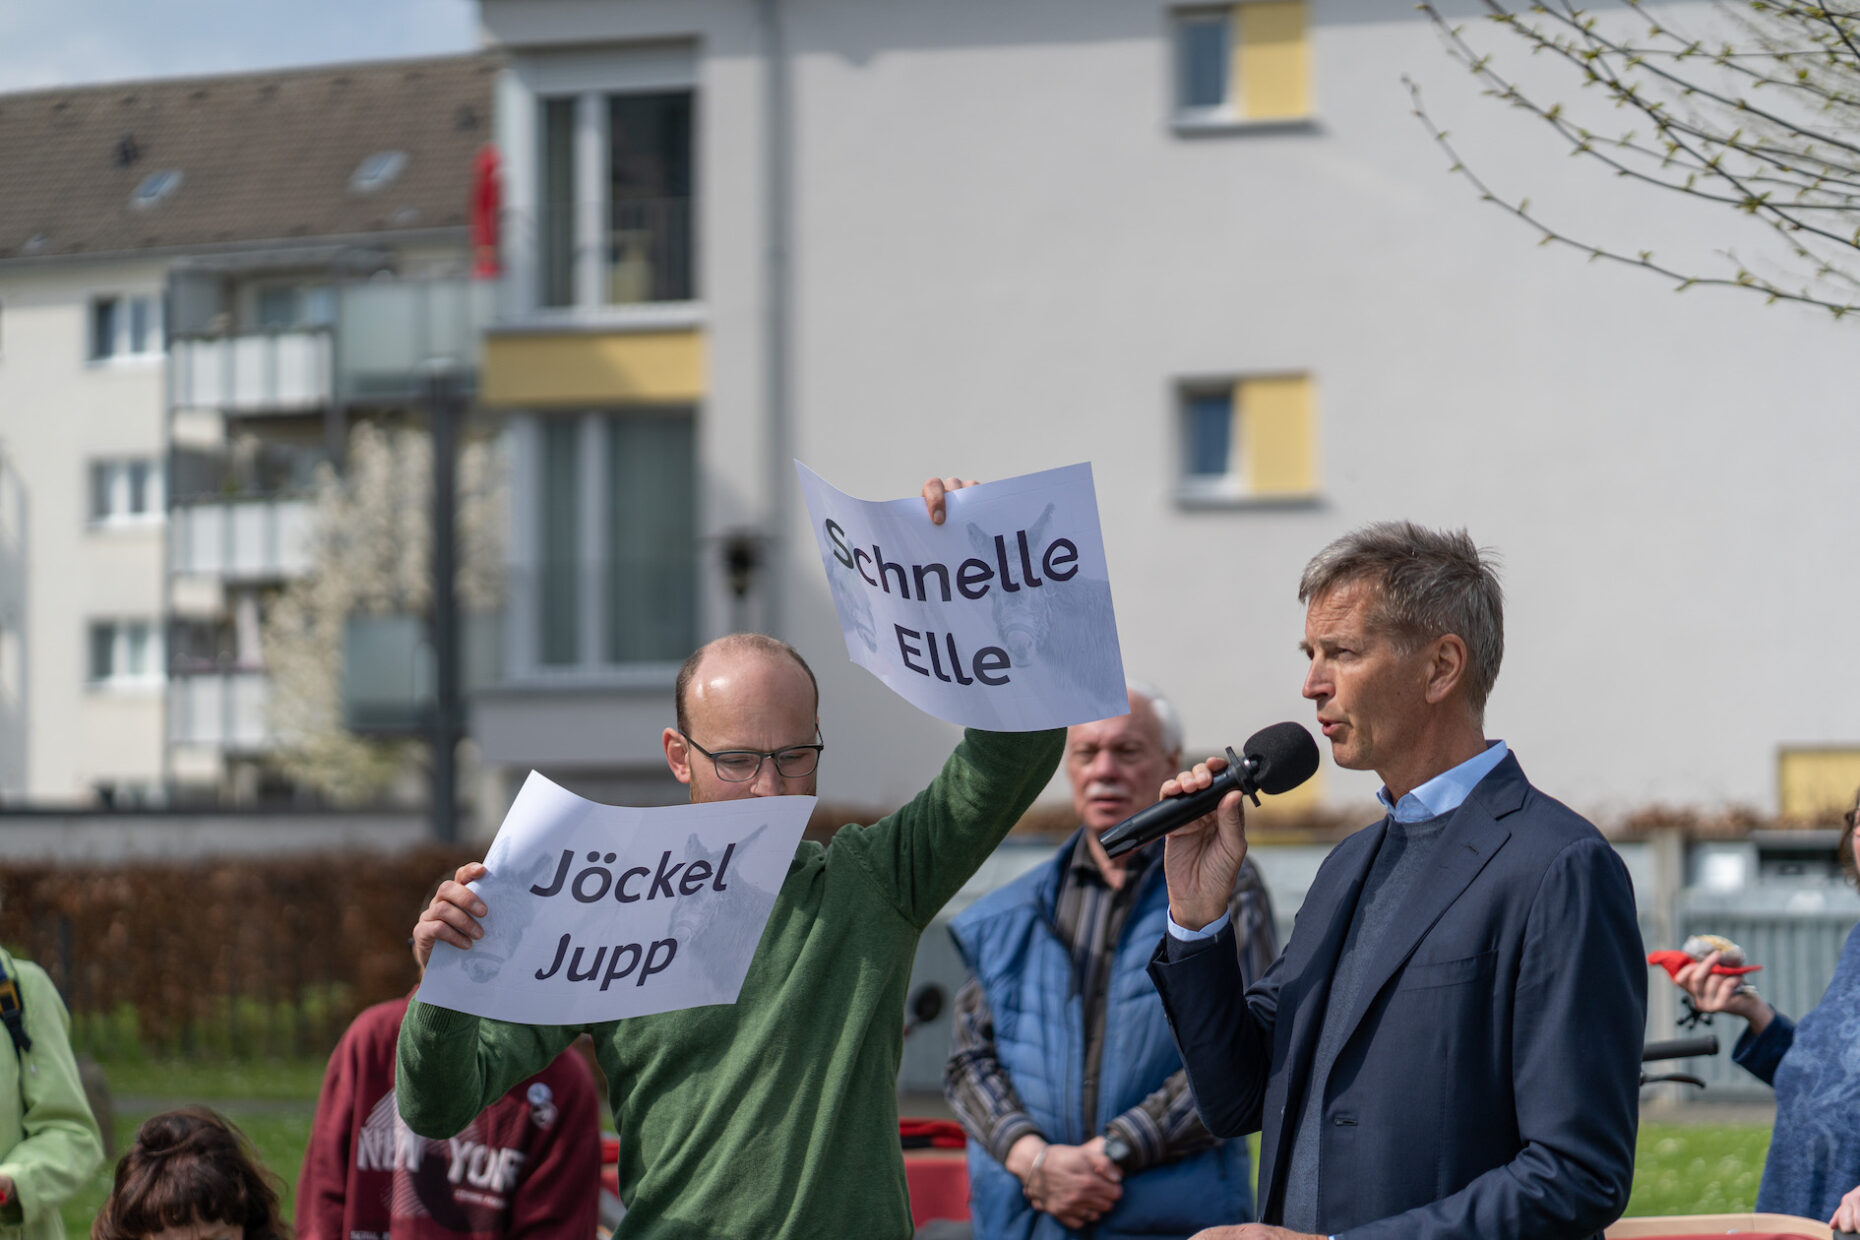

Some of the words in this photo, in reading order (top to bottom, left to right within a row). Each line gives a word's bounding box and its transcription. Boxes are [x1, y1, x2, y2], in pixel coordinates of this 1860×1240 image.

[826, 518, 1078, 601] Schnelle
[894, 624, 1010, 686] Elle
[530, 843, 735, 903] Jöckel
[535, 934, 677, 991] Jupp
[448, 1138, 525, 1191] YOR
